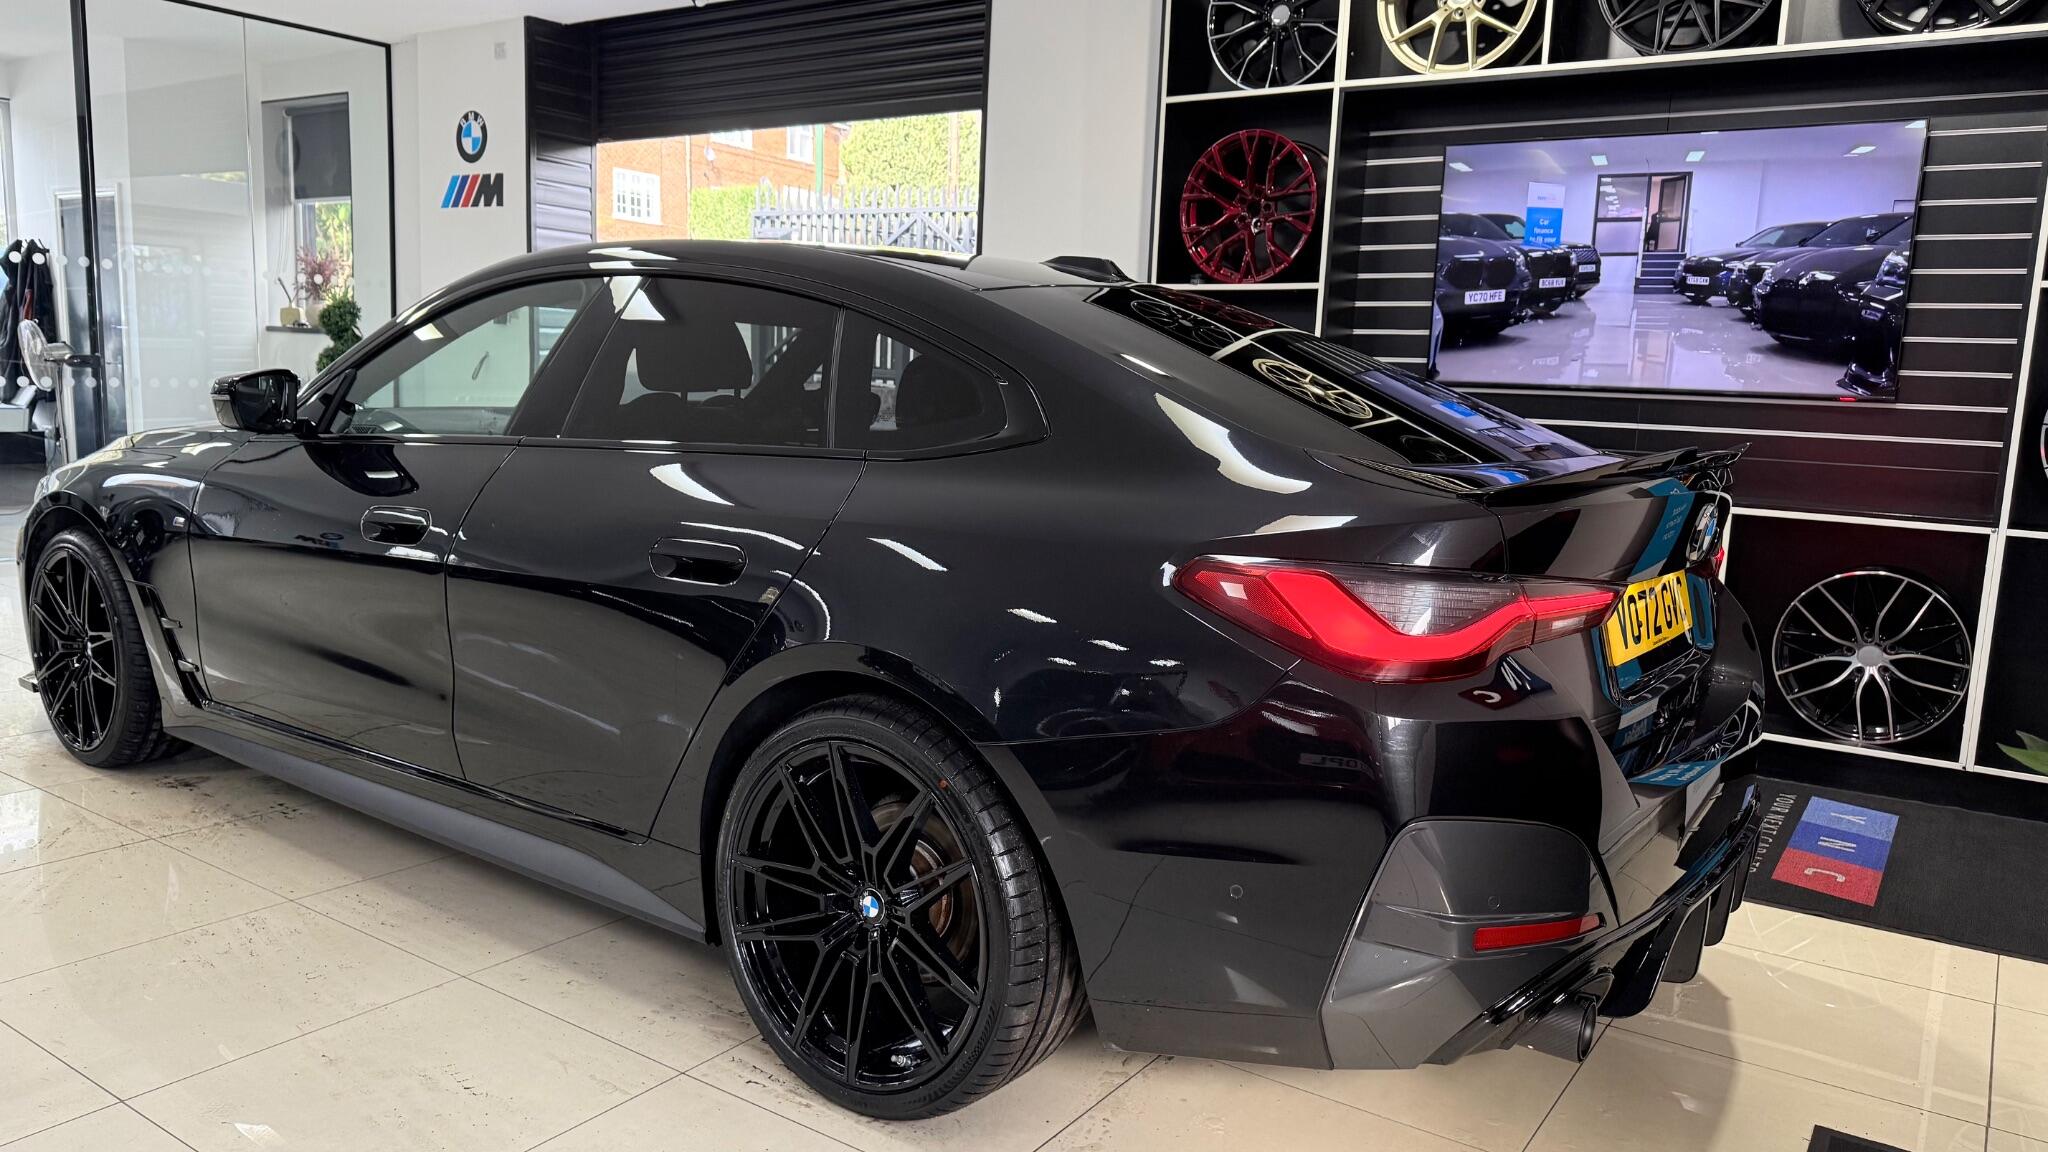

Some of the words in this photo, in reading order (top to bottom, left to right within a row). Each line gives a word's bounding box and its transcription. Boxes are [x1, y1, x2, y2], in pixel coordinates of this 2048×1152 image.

[460, 112, 485, 127] BMW
[1468, 293, 1488, 303] YC70
[1489, 291, 1502, 301] HFE
[1616, 587, 1662, 649] VO72
[1770, 793, 1798, 813] YOUR
[1762, 813, 1785, 835] NEXT
